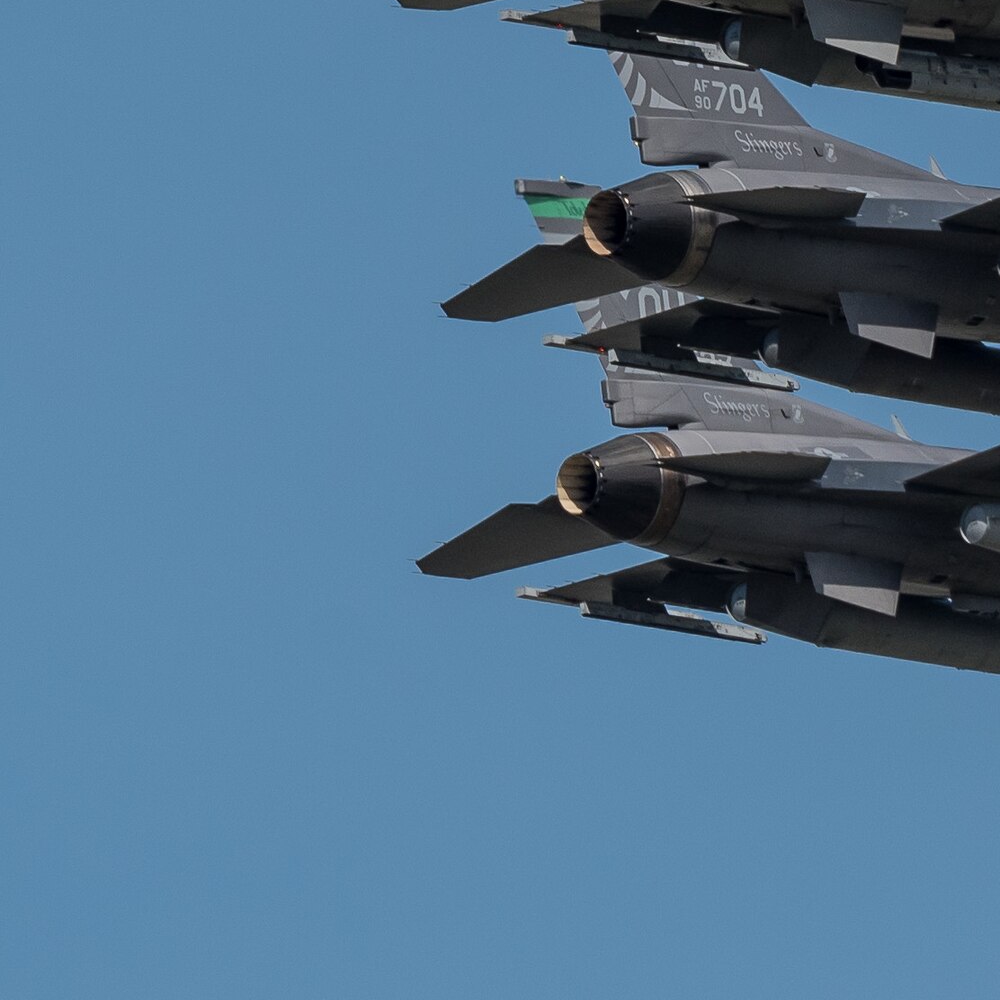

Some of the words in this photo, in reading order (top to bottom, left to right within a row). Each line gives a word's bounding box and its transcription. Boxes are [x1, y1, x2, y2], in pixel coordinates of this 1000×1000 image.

[693, 78, 710, 93] AF
[711, 81, 763, 117] 704
[694, 95, 711, 110] 90
[734, 130, 804, 160] Stingers
[703, 391, 770, 422] Stingers
